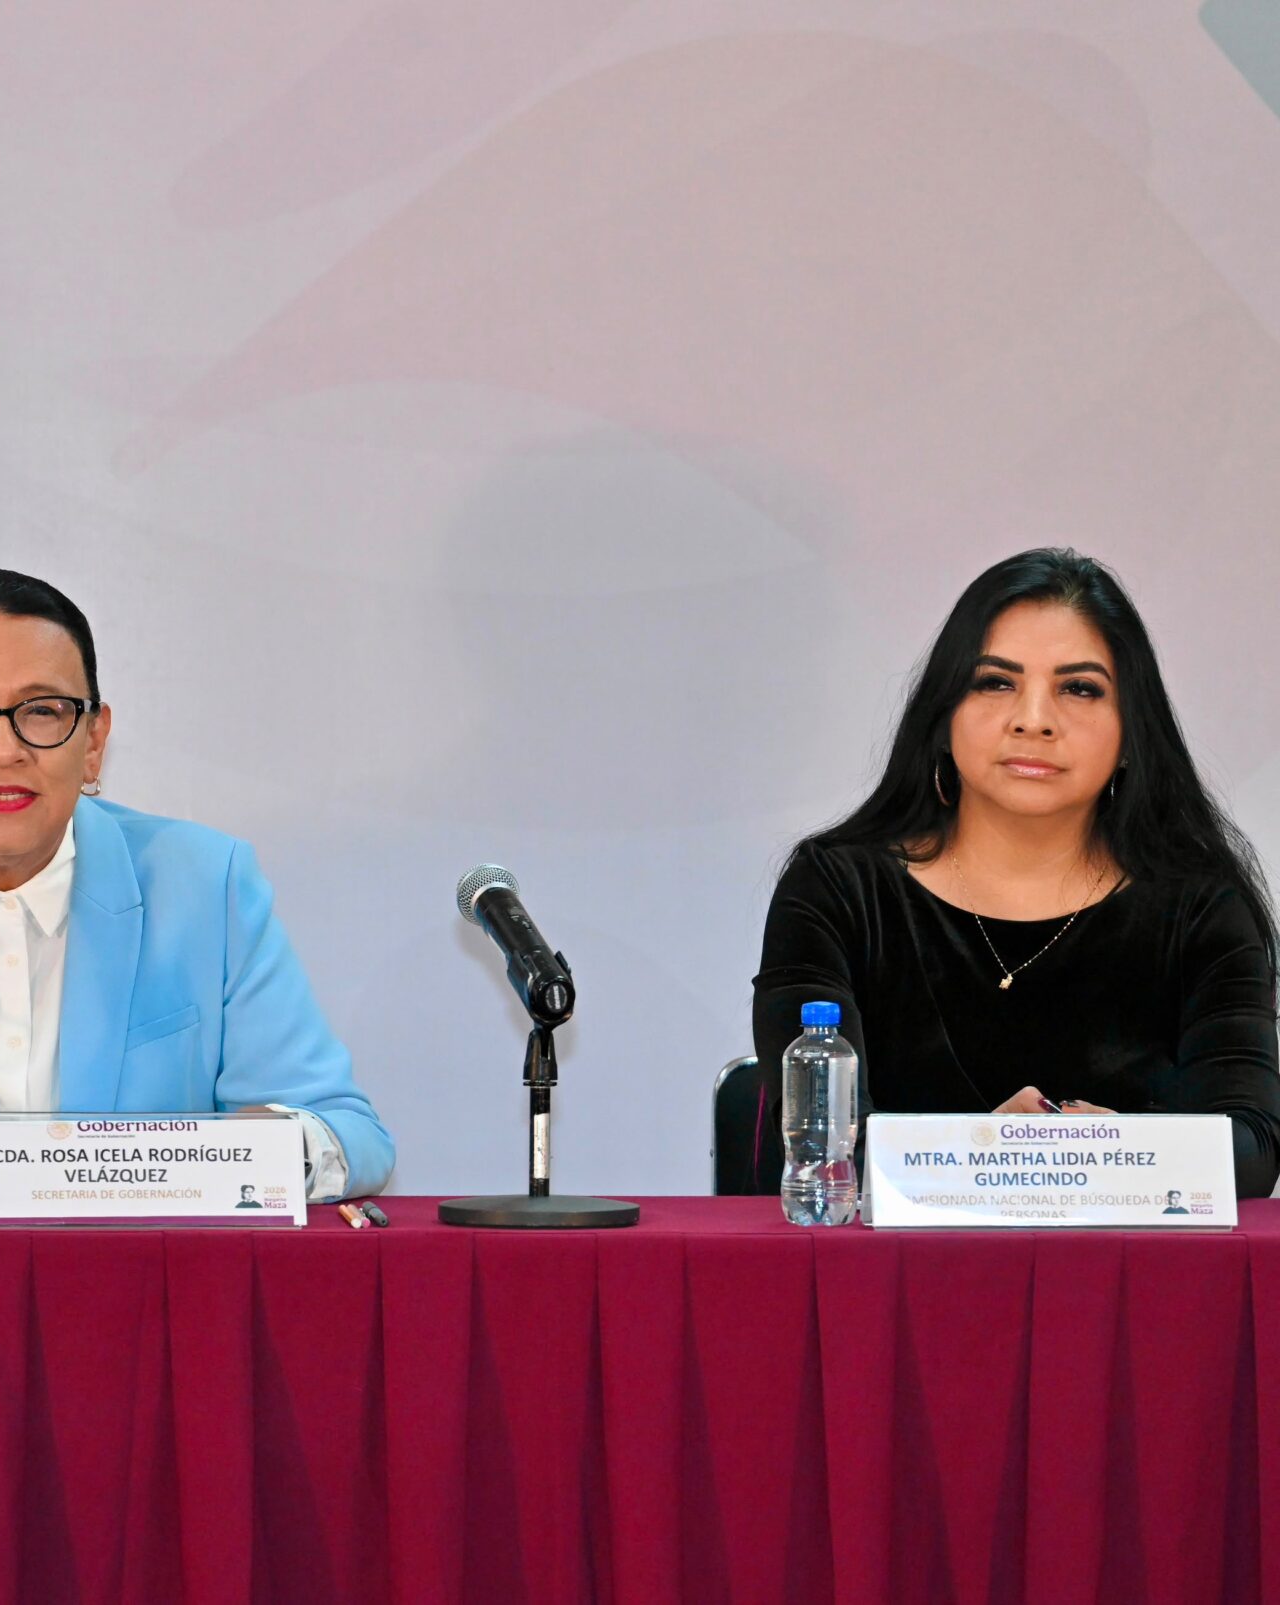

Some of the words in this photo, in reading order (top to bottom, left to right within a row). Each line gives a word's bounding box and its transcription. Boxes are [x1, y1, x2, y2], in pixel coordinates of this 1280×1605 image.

[1000, 1124, 1121, 1139] Gobernación
[41, 1148, 89, 1163] ROSA
[95, 1148, 143, 1162] ICELA
[148, 1145, 253, 1162] RODRÍGUEZ
[904, 1152, 963, 1166] MTRA.
[968, 1152, 1047, 1166] MARTHA
[1052, 1151, 1098, 1166] LIDIA
[1103, 1148, 1157, 1166] PÉREZ
[64, 1165, 168, 1184] VELÁZQUEZ
[974, 1172, 1088, 1187] GUMECINDO
[31, 1189, 98, 1200] SECRETARIA
[100, 1189, 115, 1199] DE
[118, 1187, 202, 1199] GOBERNACIÓN
[263, 1186, 287, 1194] 2026
[1060, 1194, 1076, 1206] DE
[1080, 1192, 1152, 1207] BÚSQUEDA
